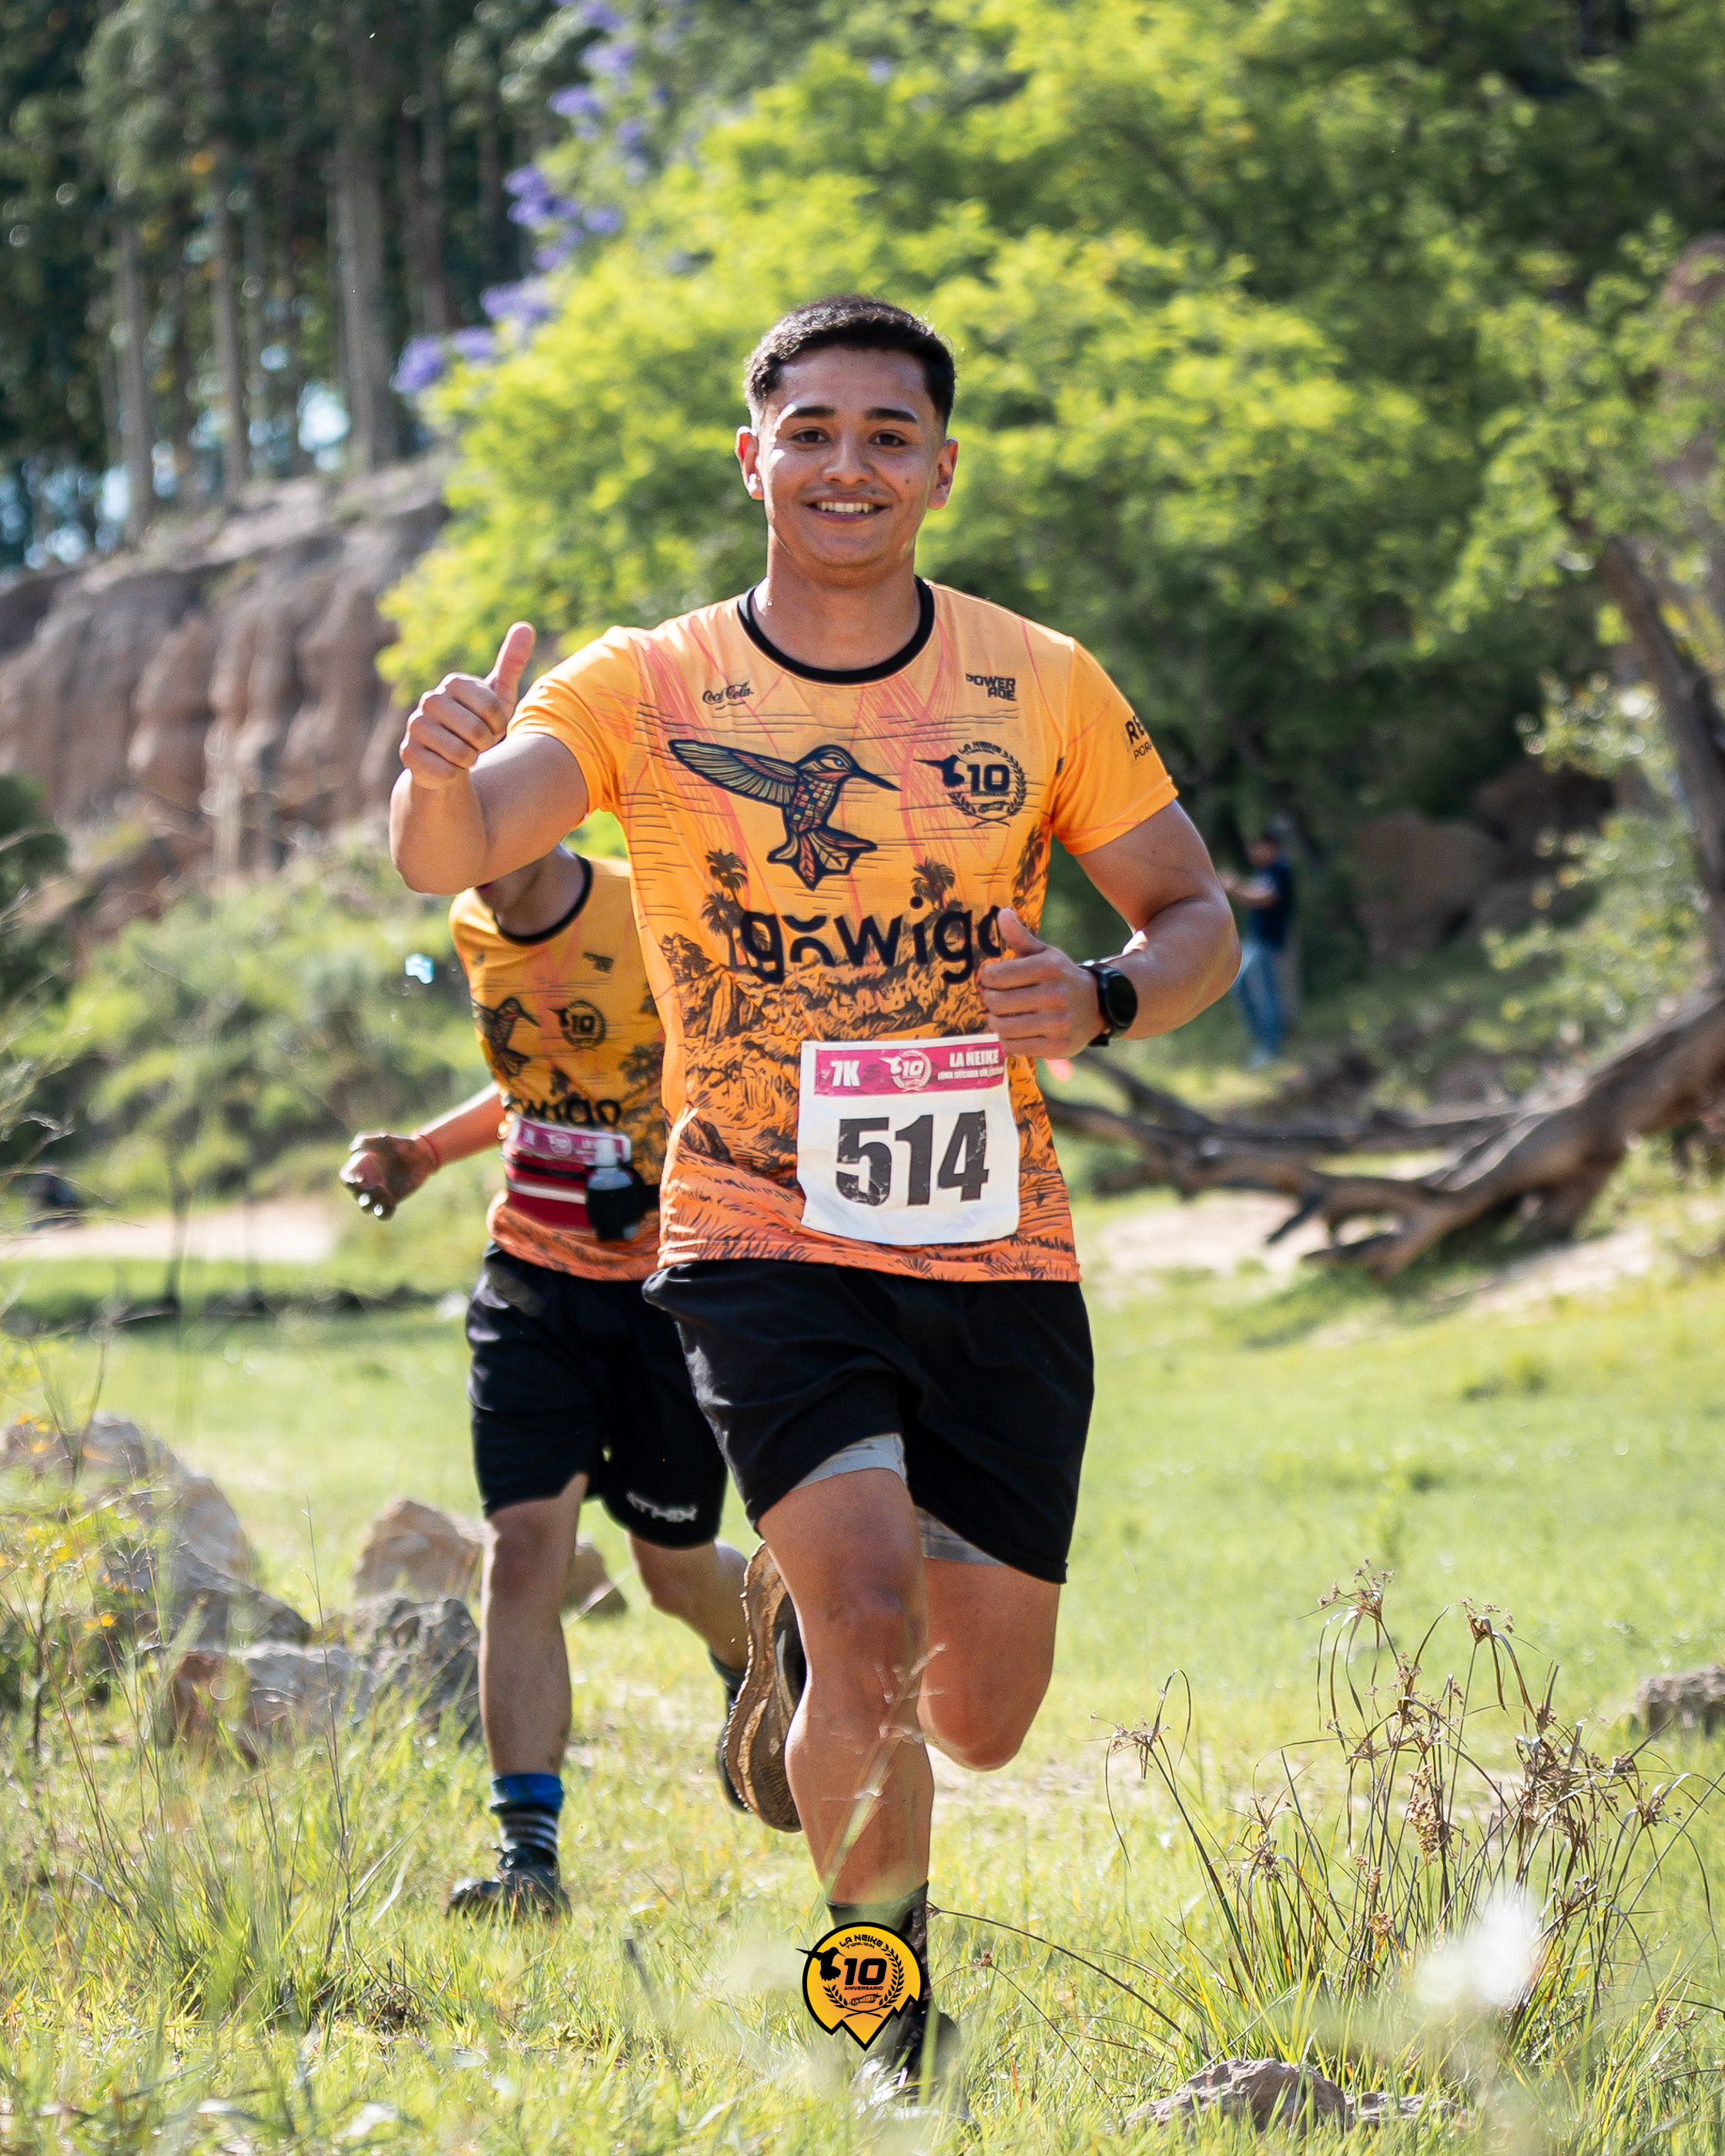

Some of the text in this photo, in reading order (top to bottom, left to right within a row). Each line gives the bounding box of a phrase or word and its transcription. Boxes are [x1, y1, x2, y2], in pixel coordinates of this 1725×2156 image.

[967, 764, 1010, 792] 10
[830, 1060, 861, 1087] 7K
[903, 1060, 924, 1077] 10
[950, 1052, 964, 1068] LA
[836, 1110, 990, 1207] 514
